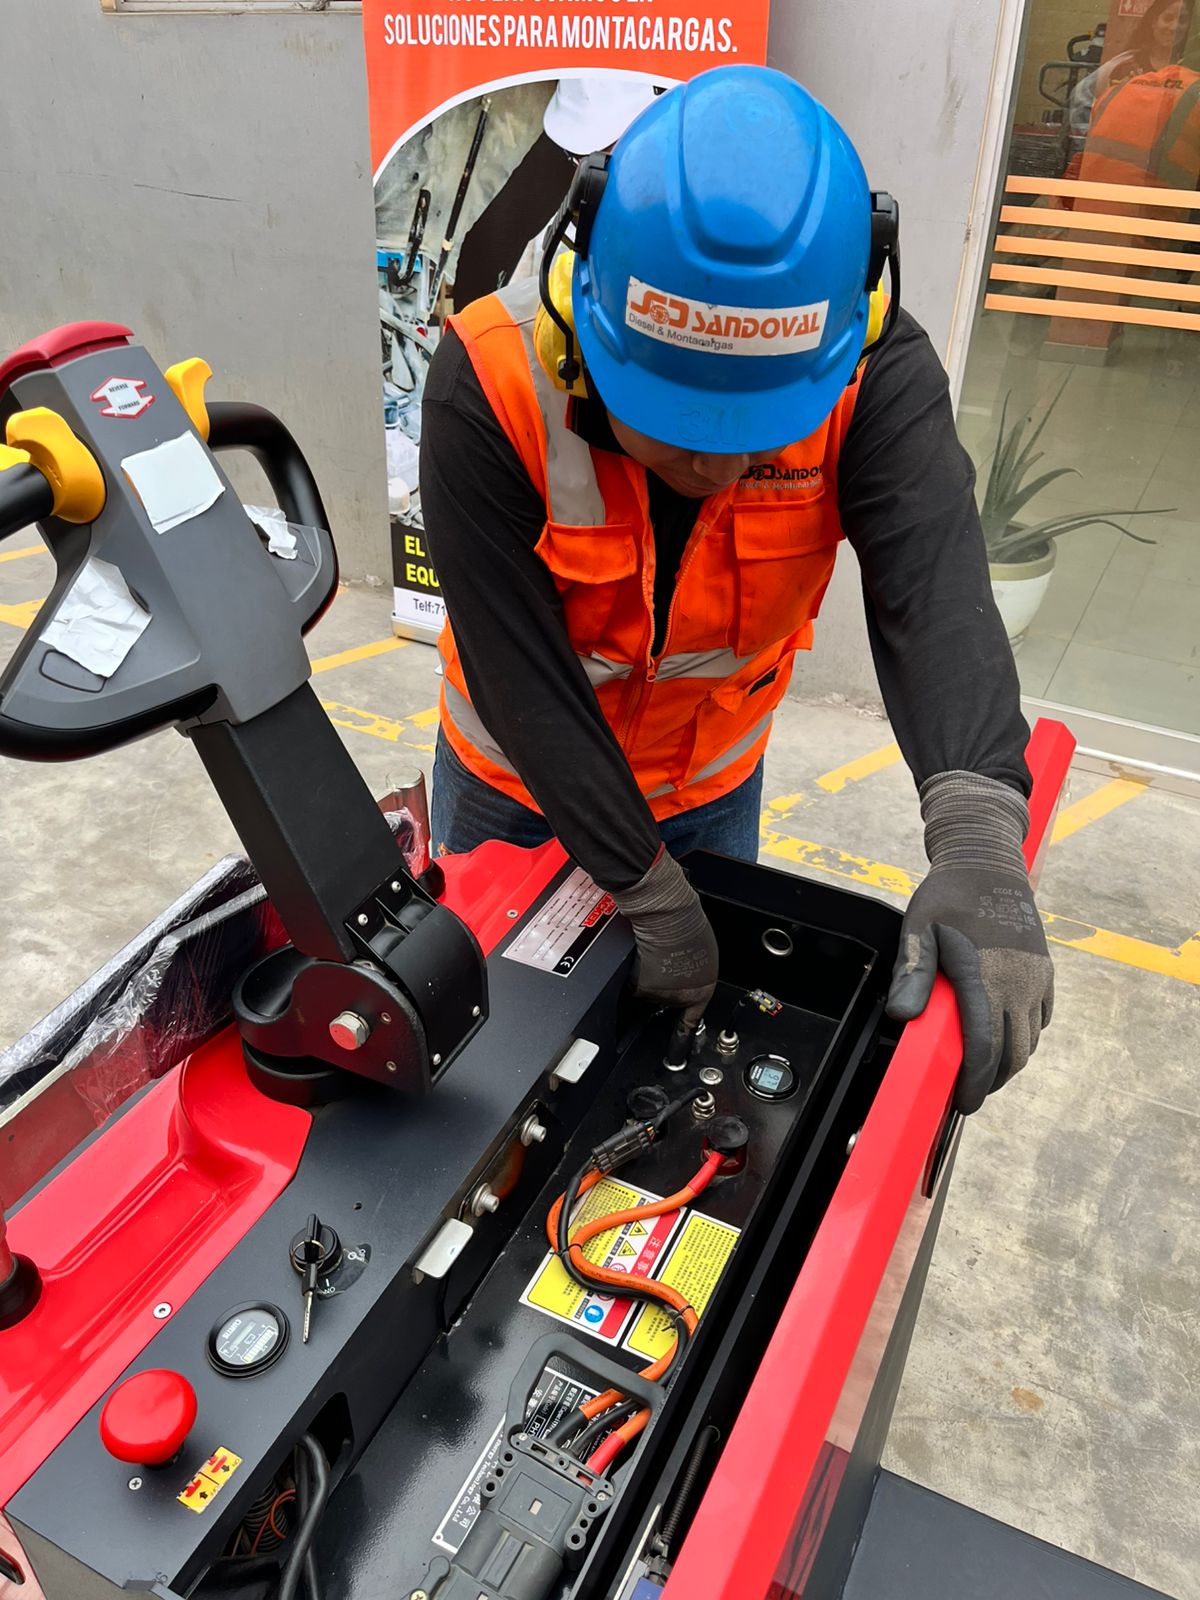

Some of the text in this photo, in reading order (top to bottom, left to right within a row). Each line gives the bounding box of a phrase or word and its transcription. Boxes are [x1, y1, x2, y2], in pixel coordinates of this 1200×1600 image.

[384, 13, 738, 53] SOLUCIONES PARA MONTACARGAS.
[628, 312, 655, 333] Diesel
[658, 326, 665, 337] &
[691, 310, 821, 340] SANDOVAL
[776, 466, 822, 481] SANDO
[404, 535, 425, 557] EL
[406, 563, 440, 587] EQU
[413, 597, 445, 615] Telf:71
[635, 1237, 662, 1273] 注意事
